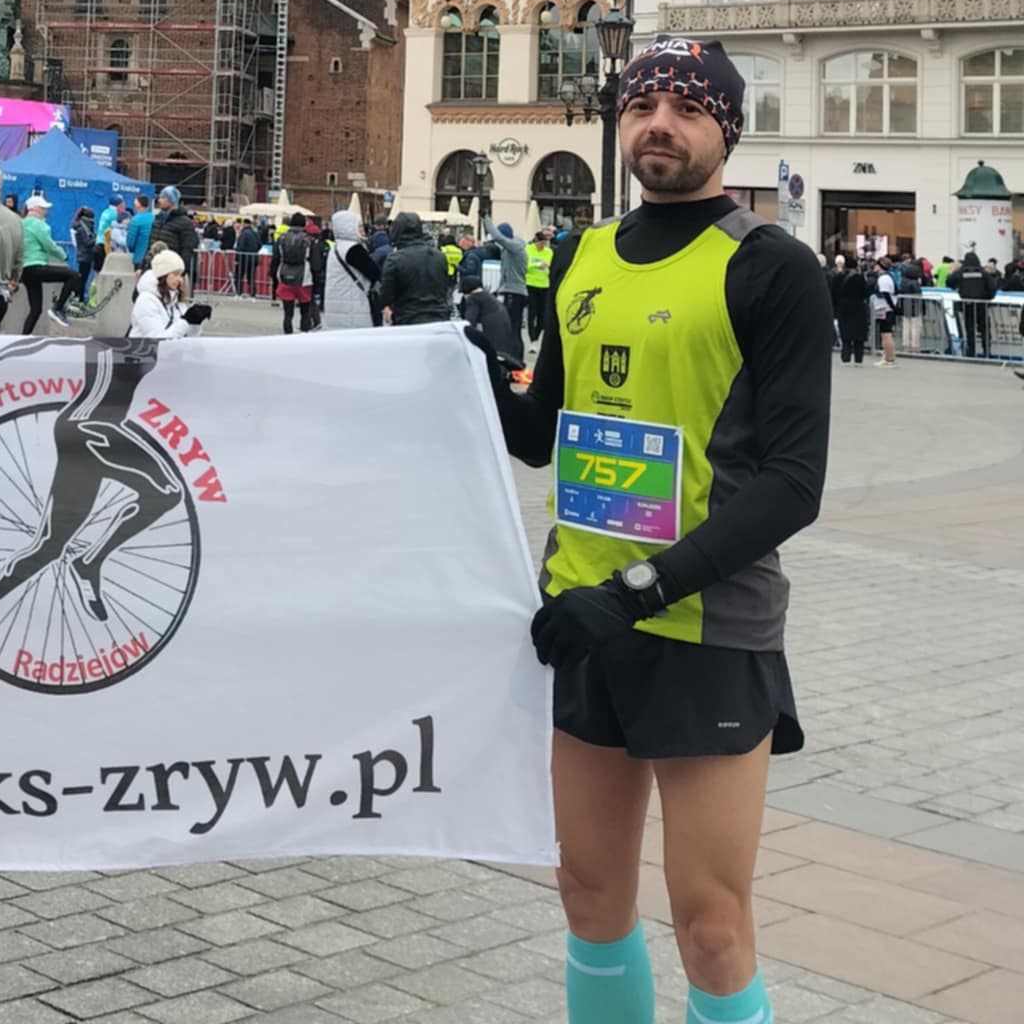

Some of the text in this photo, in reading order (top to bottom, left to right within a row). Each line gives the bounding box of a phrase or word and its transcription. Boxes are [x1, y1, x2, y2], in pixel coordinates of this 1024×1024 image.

[138, 397, 228, 505] ZRYW
[576, 452, 647, 490] 757
[13, 631, 151, 683] Radziejów
